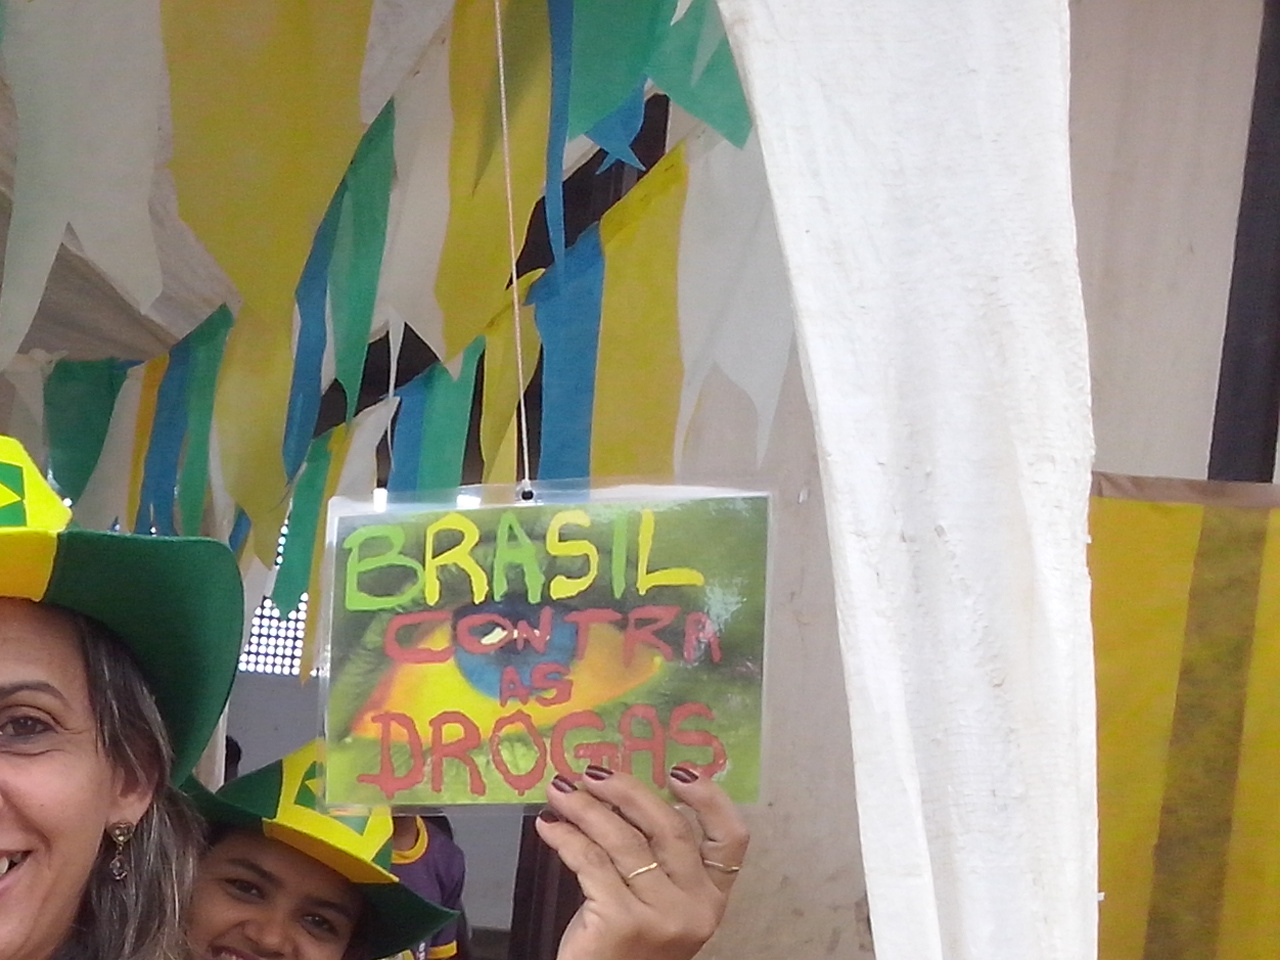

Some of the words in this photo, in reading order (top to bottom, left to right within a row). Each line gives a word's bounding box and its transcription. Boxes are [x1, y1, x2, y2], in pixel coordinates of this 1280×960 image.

[343, 509, 705, 611] BRASIL
[384, 604, 722, 664] CONTRA
[499, 662, 575, 708] AS
[357, 702, 728, 798] DROGAS
